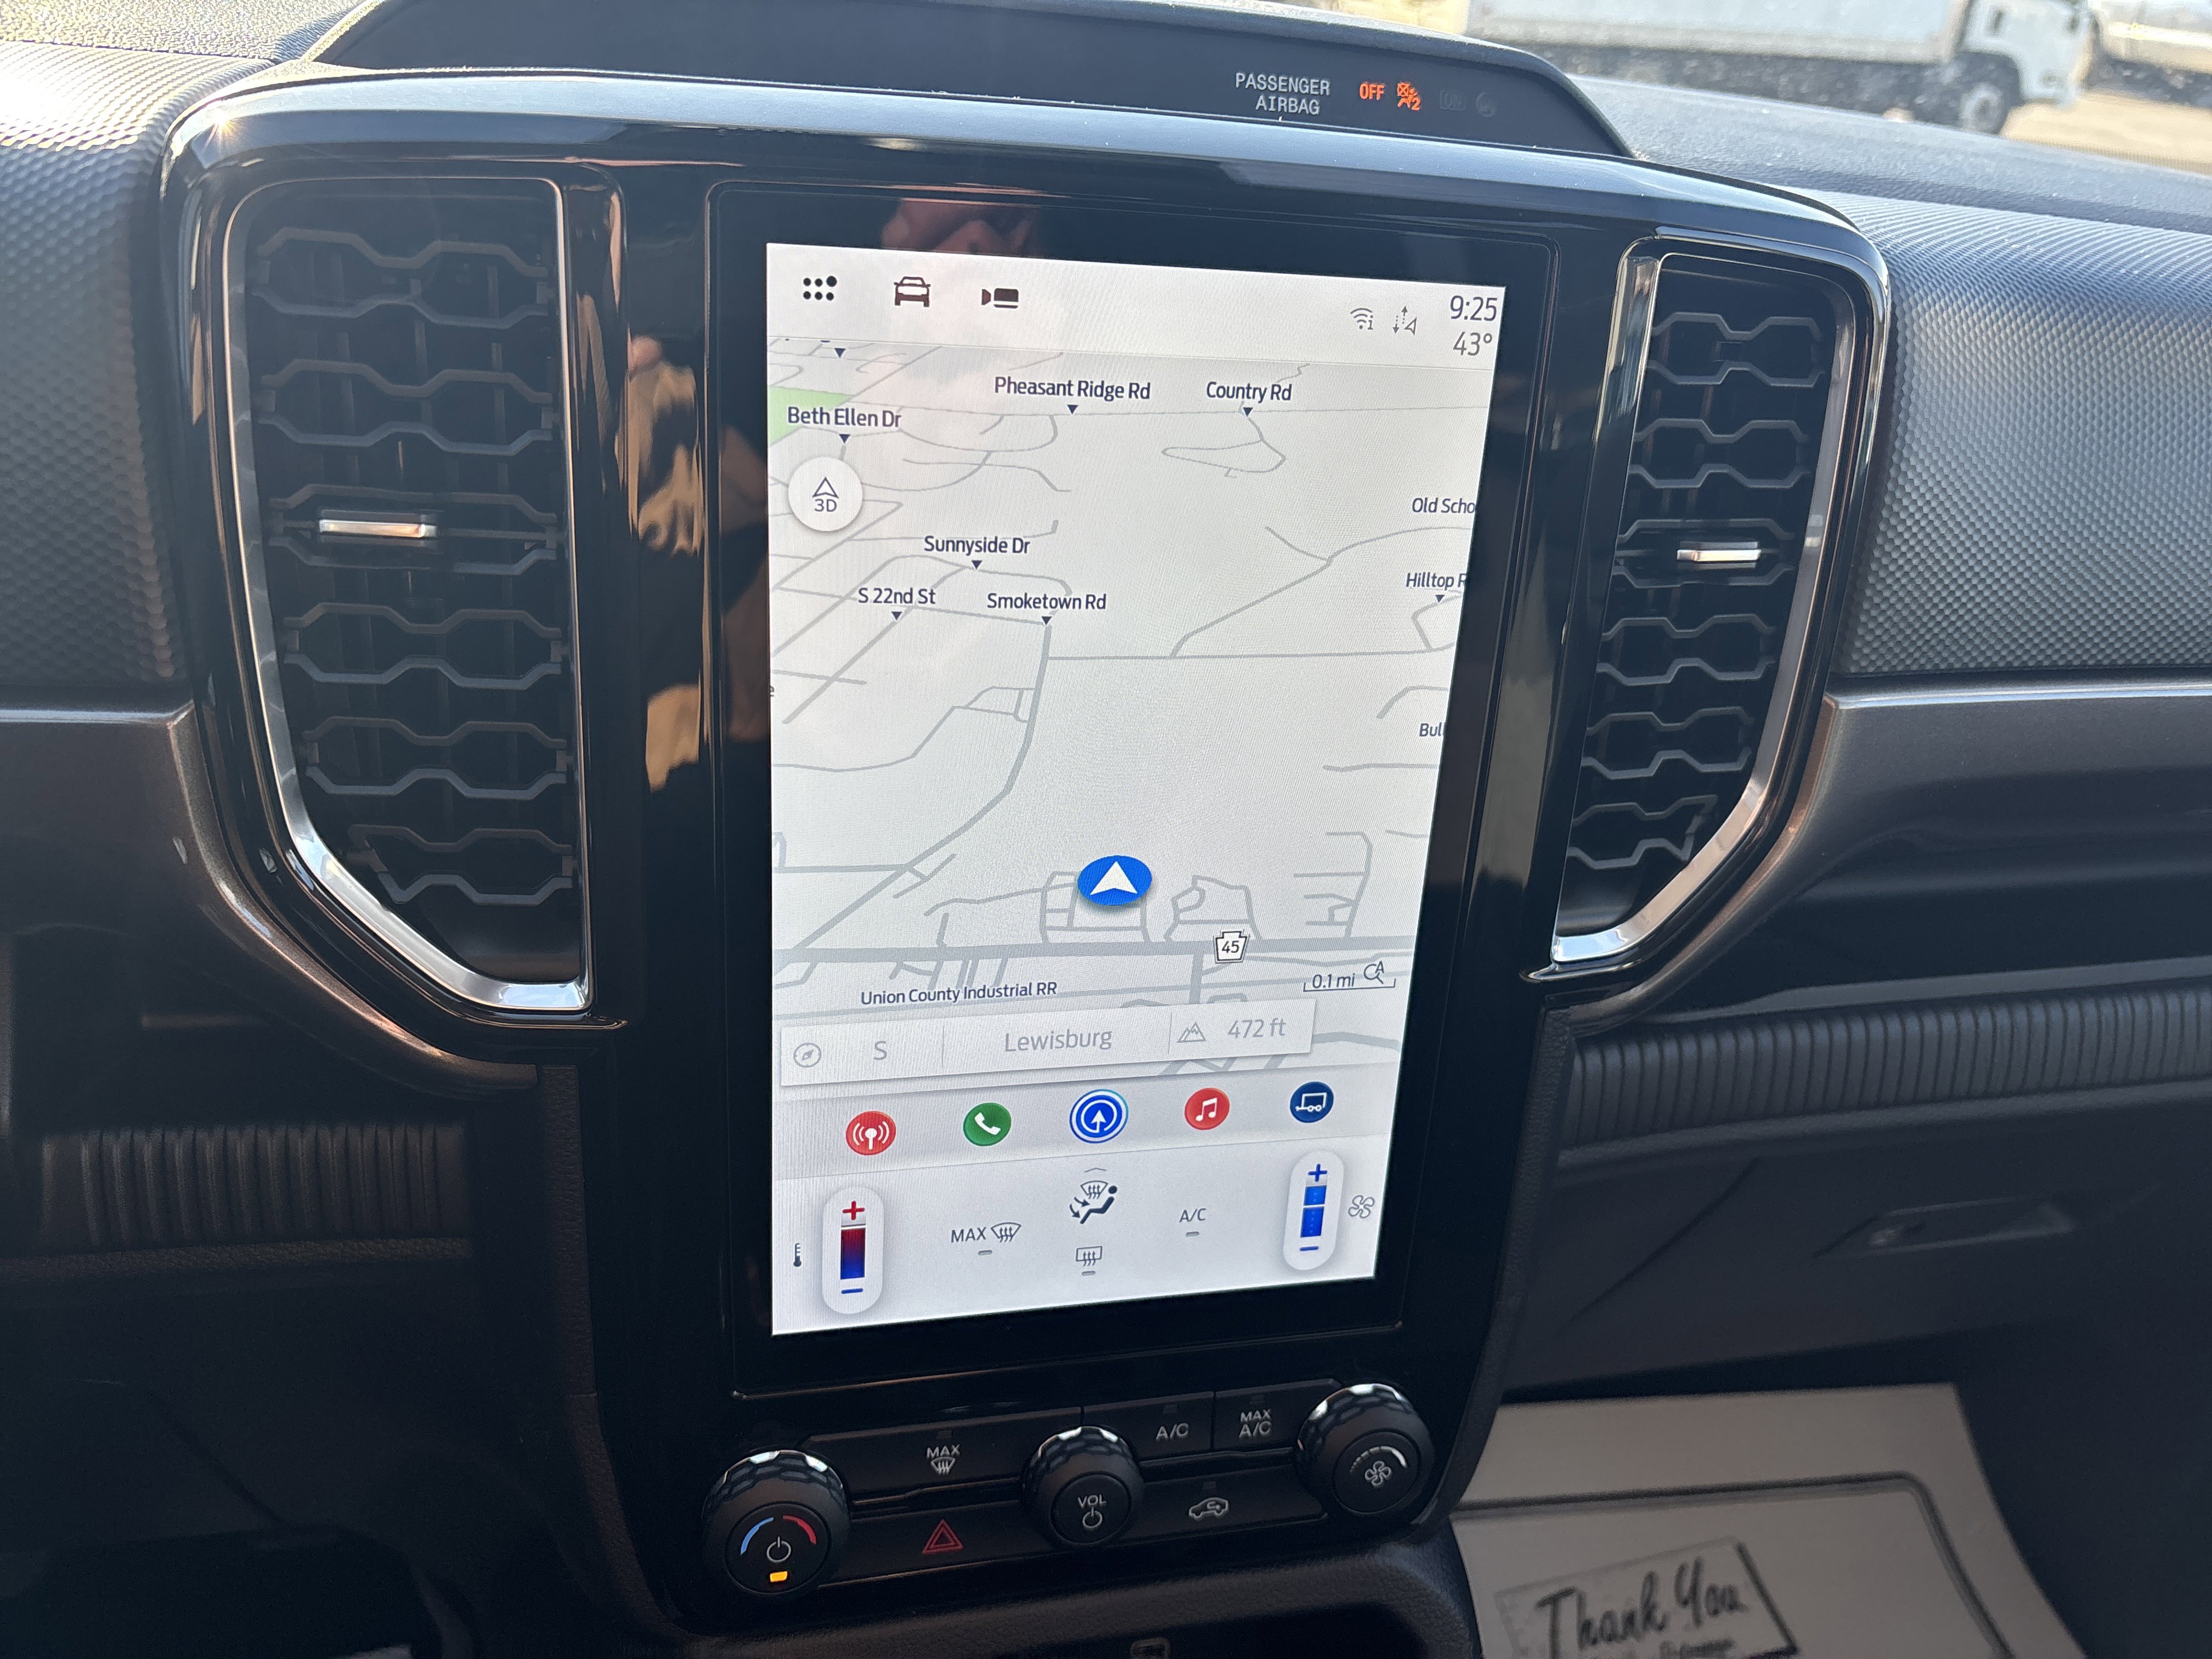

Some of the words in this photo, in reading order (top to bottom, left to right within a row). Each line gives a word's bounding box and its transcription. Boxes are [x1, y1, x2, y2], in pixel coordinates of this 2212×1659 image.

[1235, 72, 1330, 96] PASSENGER
[1359, 82, 1385, 100] OFF
[1255, 95, 1321, 115] AIRBAG
[1449, 295, 1498, 321] 9:25
[1453, 331, 1493, 356] 43°
[995, 377, 1074, 396] Pheasant
[1077, 380, 1124, 401] Ridge
[1128, 383, 1150, 399] Rd
[1206, 382, 1267, 403] Country
[1271, 384, 1291, 400] Rd
[788, 406, 831, 425] Beth
[834, 408, 878, 426] Ellen
[882, 410, 901, 427] Dr
[814, 499, 837, 512] 3D
[1412, 497, 1438, 513] Old
[1441, 498, 1475, 513] Scho
[924, 535, 1008, 556] Sunnyside
[1012, 538, 1030, 554] Dr
[1406, 572, 1454, 590] Hilltop
[858, 588, 869, 603] S
[873, 588, 913, 604] 22nd
[917, 589, 936, 604] St
[988, 593, 1081, 610] Smoketown
[1085, 594, 1106, 610] Rd
[1222, 940, 1239, 953] 45
[1312, 974, 1332, 989] 0.1
[1336, 973, 1355, 988] mi
[861, 989, 905, 1005] Union
[909, 987, 960, 1003] County
[964, 983, 1032, 1000] Industrial
[1037, 982, 1058, 996] RR
[1227, 1019, 1263, 1039] 472
[1269, 1018, 1286, 1037] ft
[1005, 1029, 1112, 1052] Lewisburg
[873, 1041, 887, 1060] S
[1179, 1209, 1206, 1223] A/C
[951, 1227, 987, 1243] MAX
[1239, 1409, 1272, 1423] MAX
[1156, 1423, 1189, 1441] A/C
[1238, 1421, 1272, 1438] A/C
[927, 1444, 960, 1459] MAX
[1077, 1495, 1107, 1508] VOL
[1534, 1571, 1669, 1659] Thank
[1674, 1557, 1748, 1627] You
